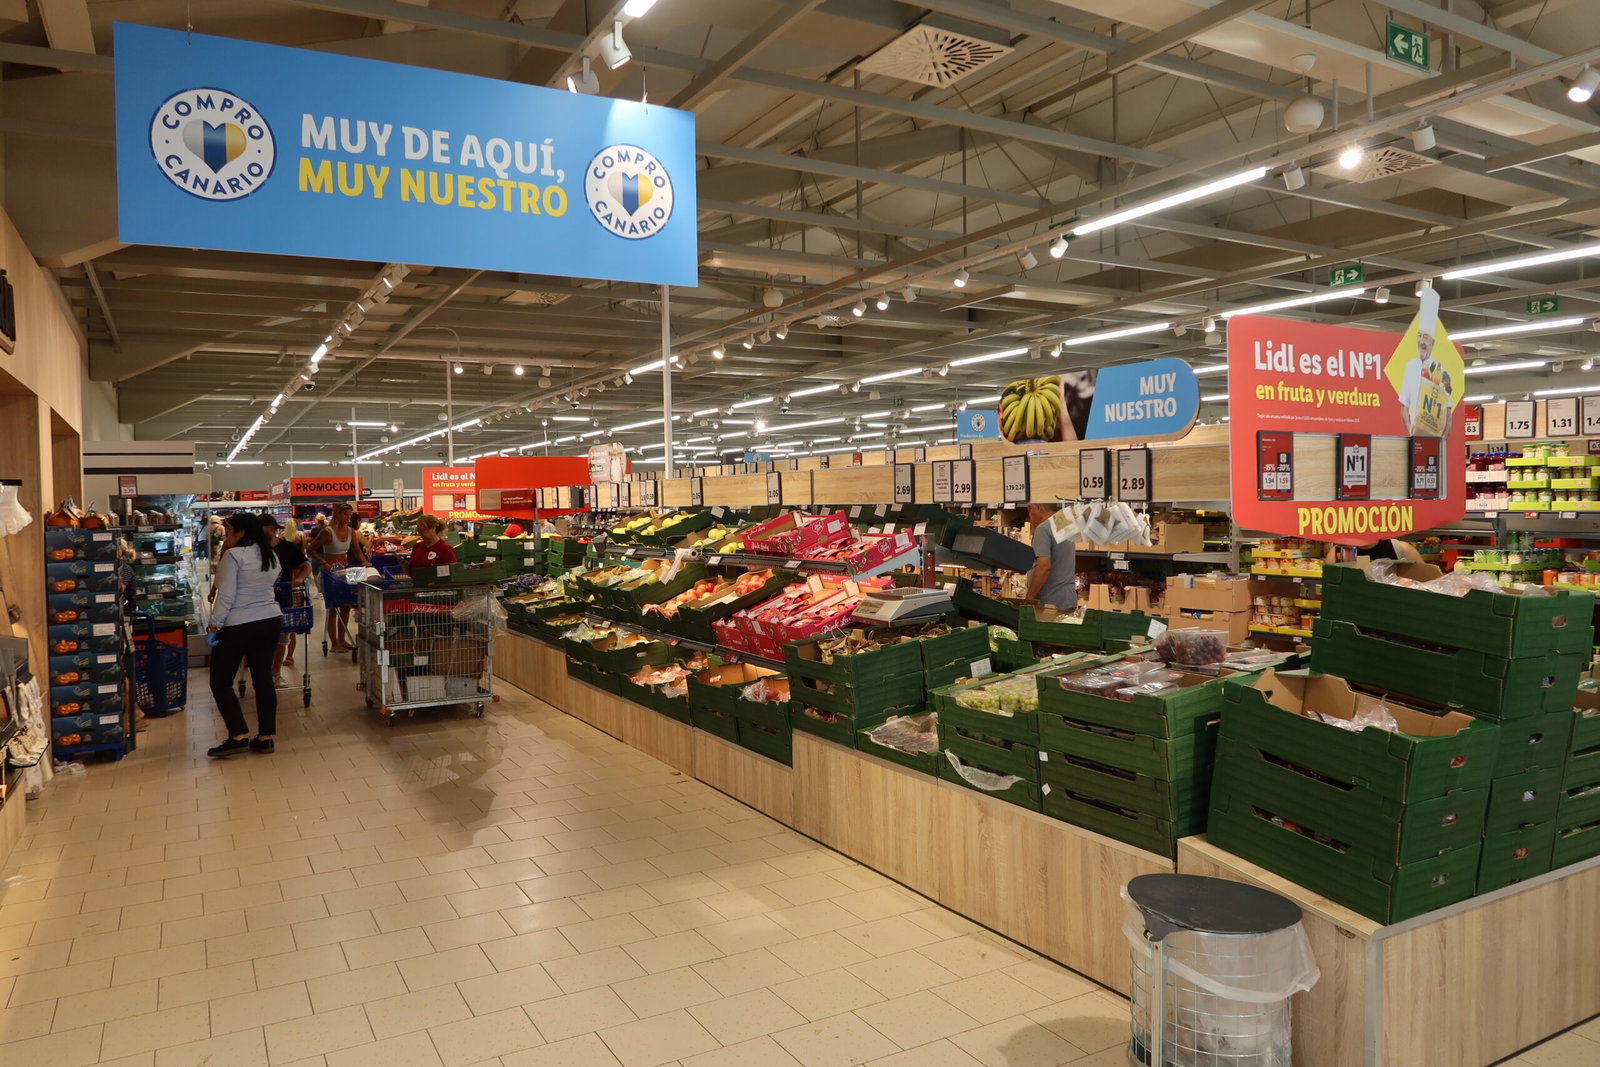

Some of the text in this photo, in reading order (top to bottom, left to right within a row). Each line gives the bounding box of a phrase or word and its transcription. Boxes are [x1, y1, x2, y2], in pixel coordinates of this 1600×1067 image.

[162, 93, 264, 140] COMPRO
[301, 113, 565, 184] MUY DE AQUÍ,
[165, 154, 264, 195] CANARIO
[593, 150, 666, 188] COMPRO
[298, 157, 568, 218] MUY NUESTRO
[595, 201, 665, 234] CANARIO
[1254, 340, 1296, 373] Lidl
[1299, 353, 1322, 375] es
[1326, 349, 1345, 377] el
[1139, 372, 1177, 396] MUY
[1255, 380, 1381, 408] en fruta y verdura
[1104, 397, 1177, 423] NUESTRO
[1465, 425, 1476, 433] .63
[1509, 420, 1530, 430] 1.75
[1551, 418, 1572, 428] 1.31
[296, 482, 356, 492] PROMOCIÓN
[432, 472, 448, 480] Lidl
[460, 472, 469, 480] el
[954, 483, 971, 493] 2.99
[1082, 476, 1104, 488] 0.59
[1121, 477, 1145, 490] 2.89
[896, 485, 911, 495] 2.69
[1297, 503, 1414, 535] PROMOCIÓN
[821, 620, 839, 634] Pink
